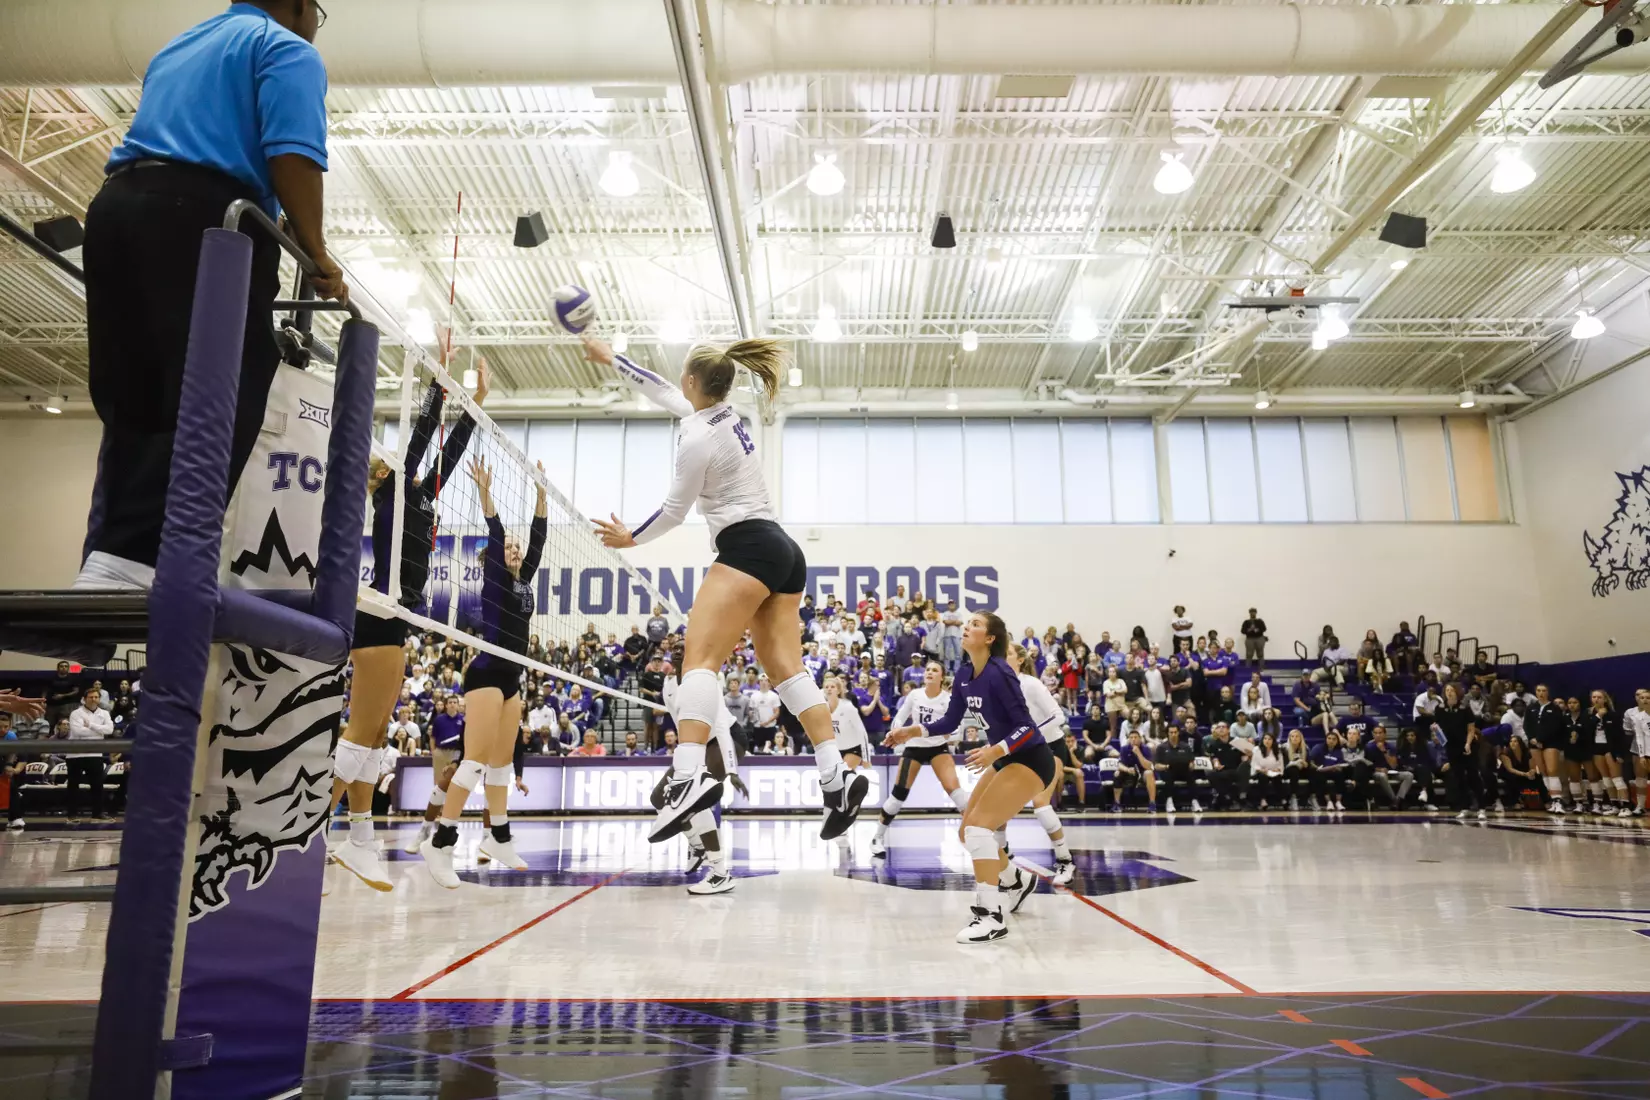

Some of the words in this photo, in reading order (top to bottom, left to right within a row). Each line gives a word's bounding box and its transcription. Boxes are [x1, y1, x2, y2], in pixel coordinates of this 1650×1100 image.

[267, 452, 328, 493] TC
[536, 567, 707, 615] HORN
[805, 566, 1000, 614] FROGS
[919, 705, 934, 714] TCU
[1346, 722, 1367, 731] TCU
[26, 763, 44, 772] TCU
[57, 763, 67, 771] TC
[1195, 758, 1208, 769] CU
[573, 770, 735, 808] HOR
[749, 769, 881, 806] FROS
